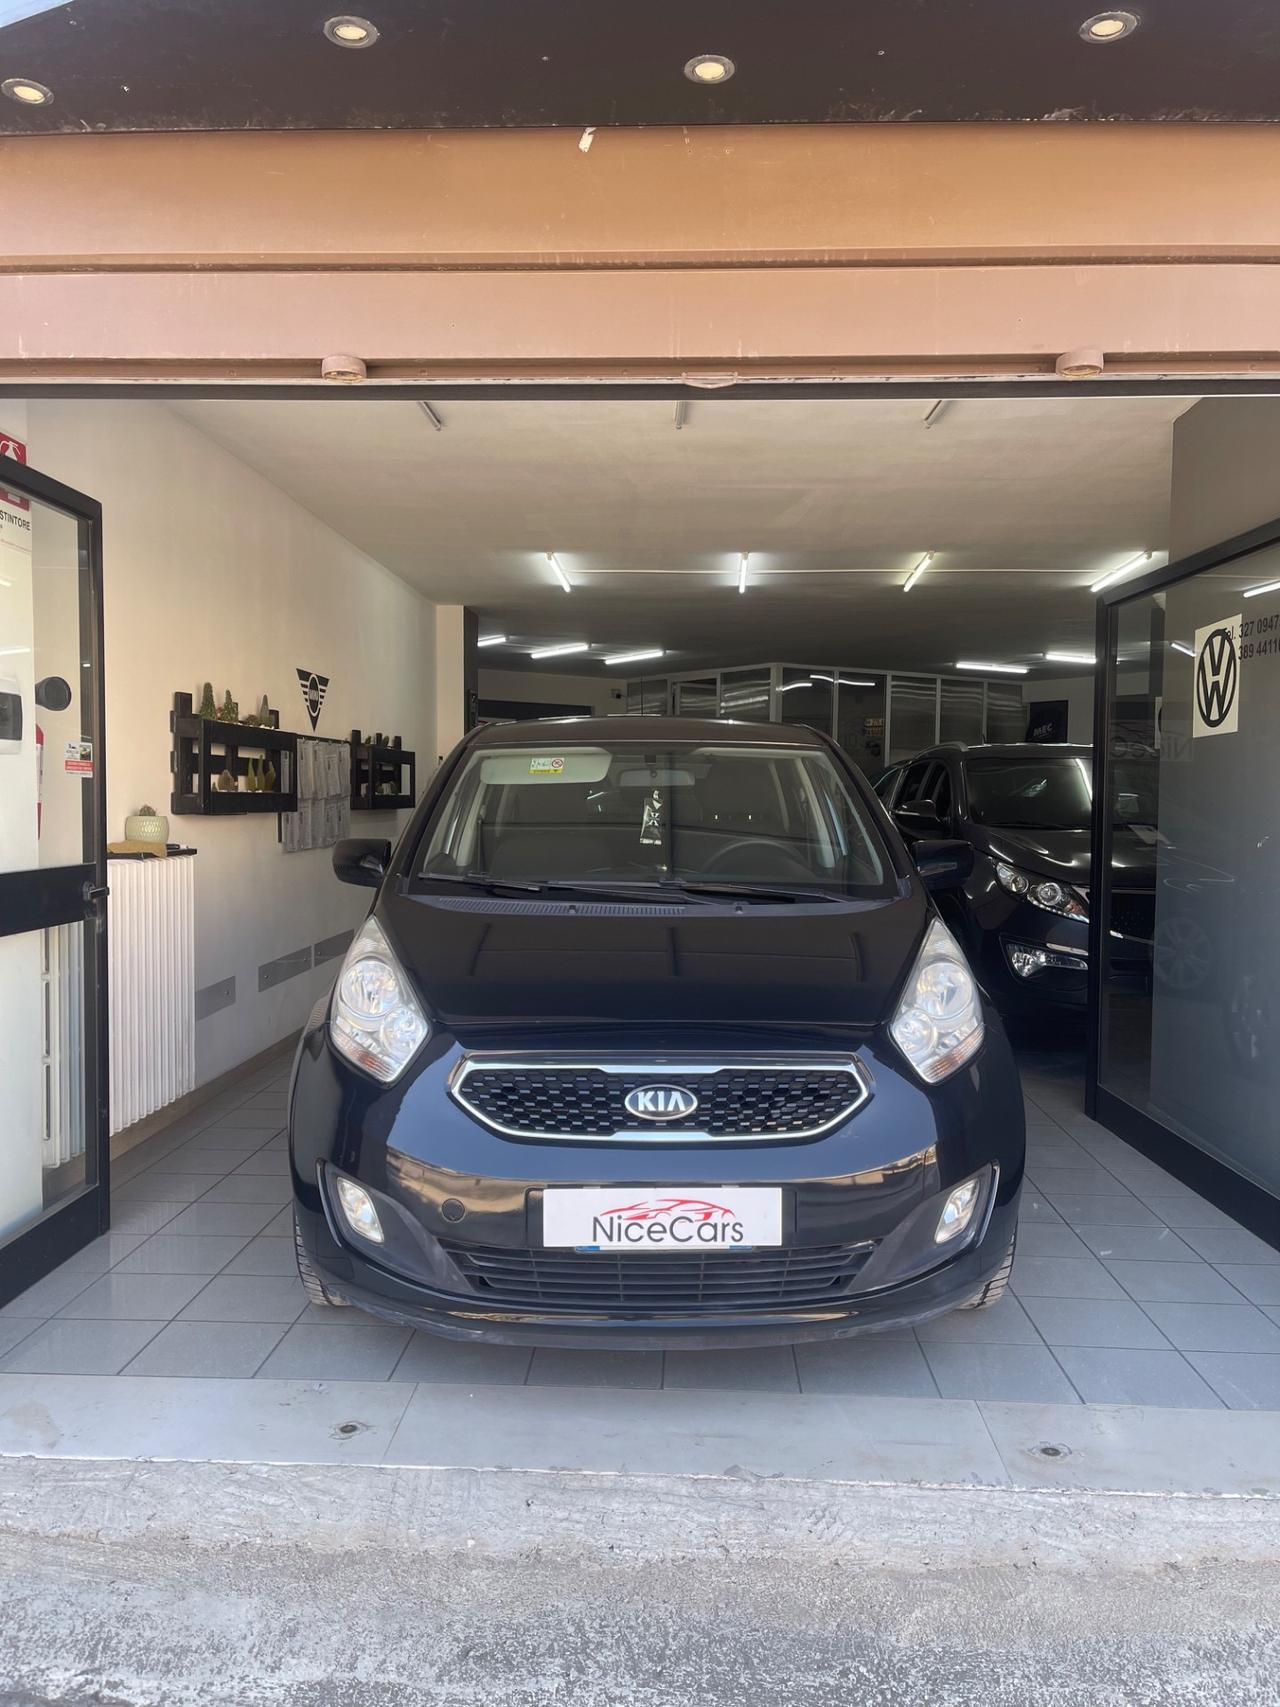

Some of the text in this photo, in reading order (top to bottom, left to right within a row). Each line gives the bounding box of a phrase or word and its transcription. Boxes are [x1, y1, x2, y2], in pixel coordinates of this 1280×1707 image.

[1238, 621, 1255, 638] 327
[1257, 614, 1280, 634] 0947
[1238, 643, 1254, 660] 389
[636, 1091, 686, 1112] KIA
[592, 1215, 744, 1243] NiceCars
